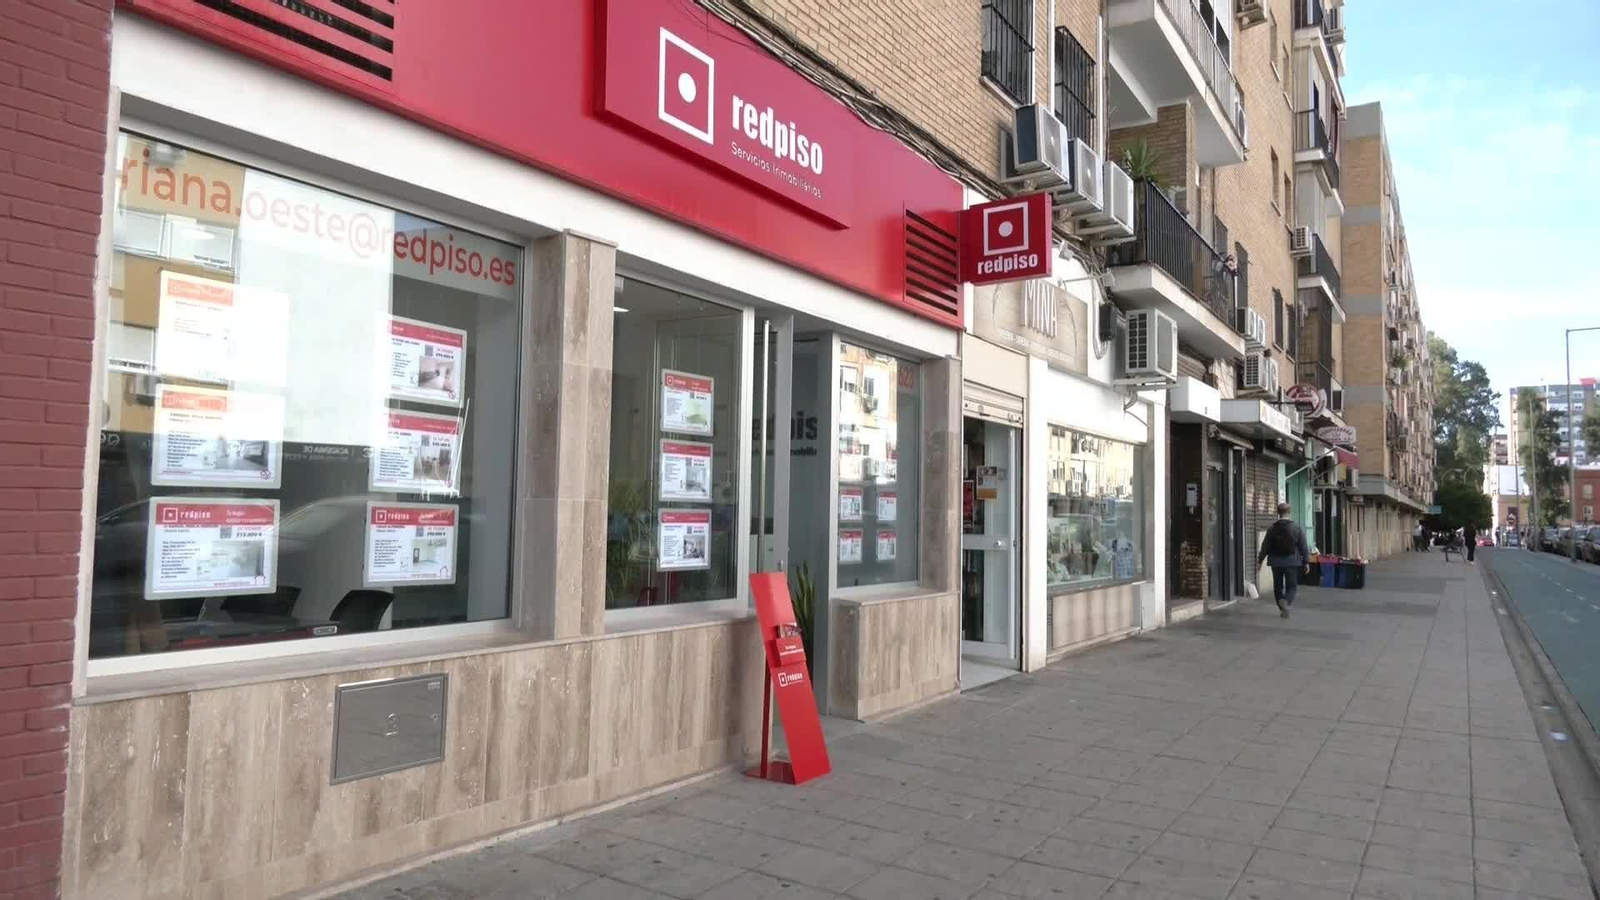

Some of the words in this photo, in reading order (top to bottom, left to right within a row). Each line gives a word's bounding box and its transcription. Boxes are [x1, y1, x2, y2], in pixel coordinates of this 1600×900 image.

[732, 94, 823, 175] redpiso
[731, 141, 771, 172] Servicios
[772, 164, 822, 198] Inmobiliarios
[977, 252, 1039, 275] redpiso
